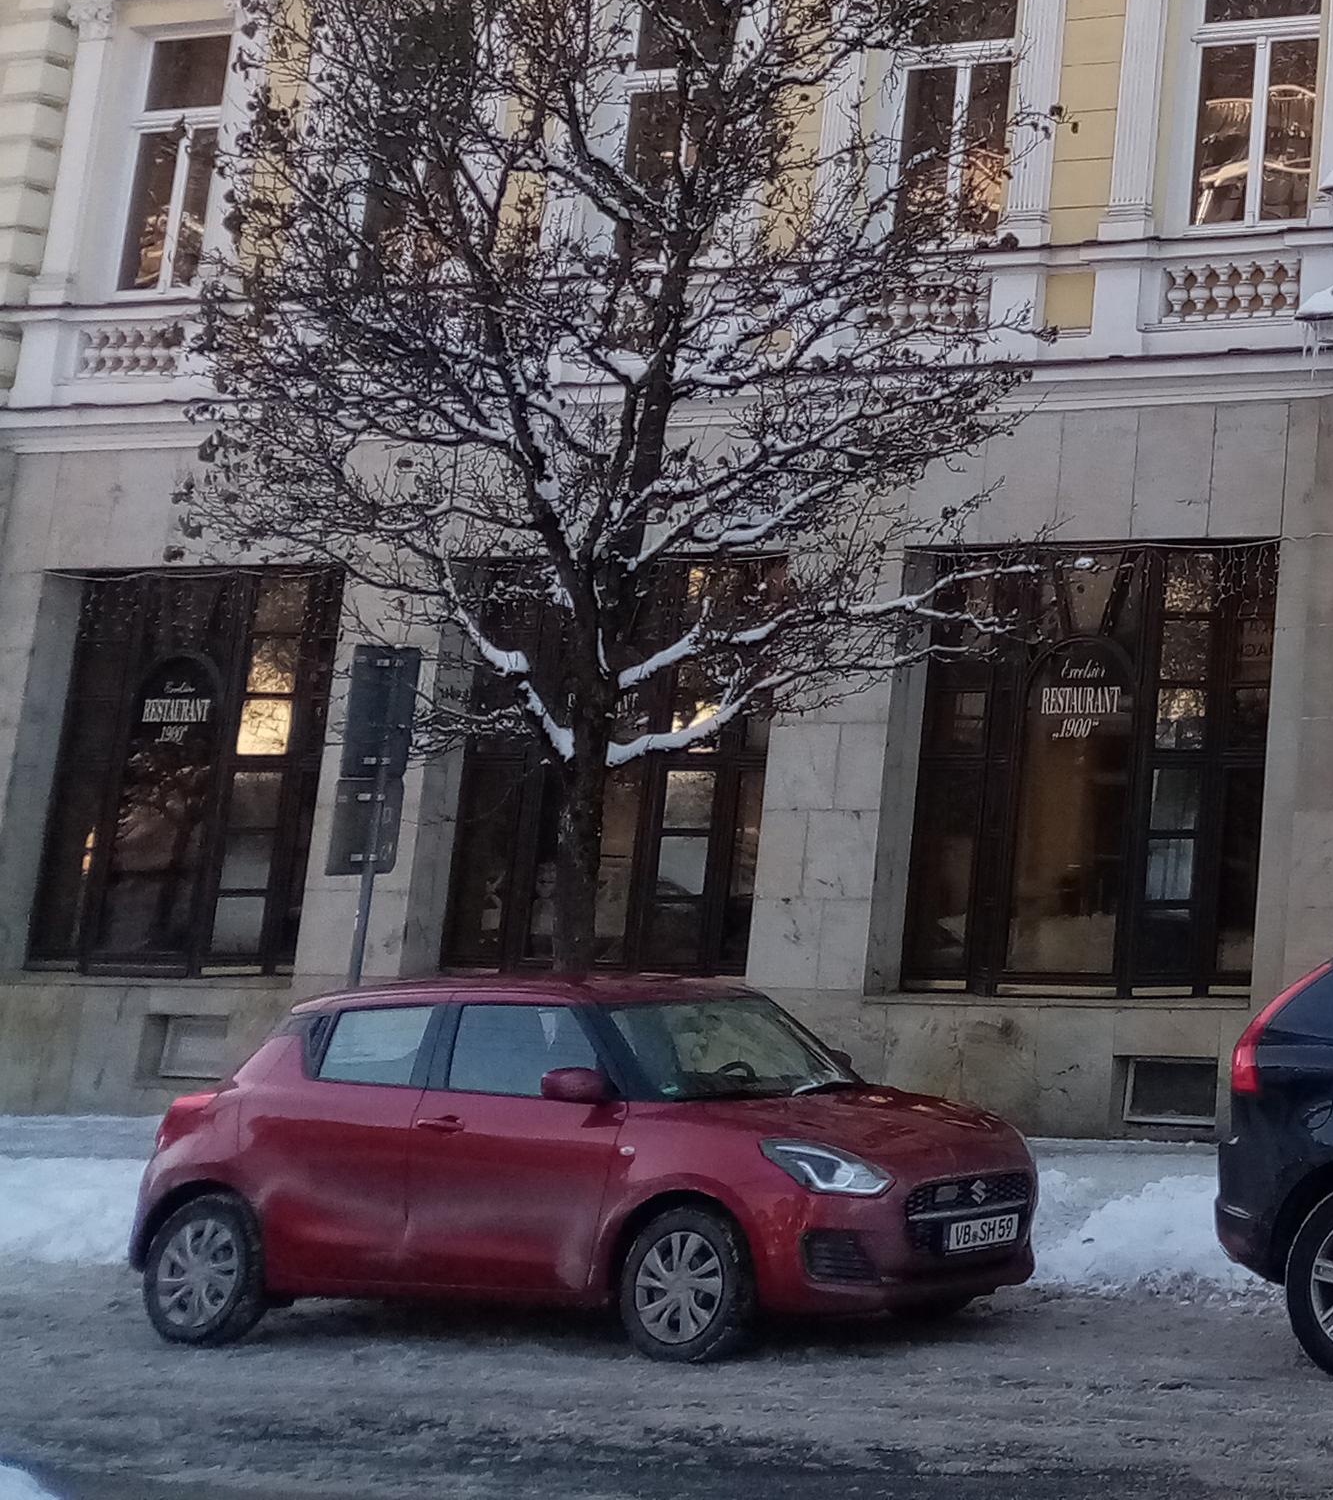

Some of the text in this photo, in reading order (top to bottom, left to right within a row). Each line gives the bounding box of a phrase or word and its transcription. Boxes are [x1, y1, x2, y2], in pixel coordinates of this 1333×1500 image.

[141, 699, 211, 723] RESTAURANT
[1041, 686, 1121, 715] RESTAURANT
[956, 1218, 1013, 1245] VB SH 59
